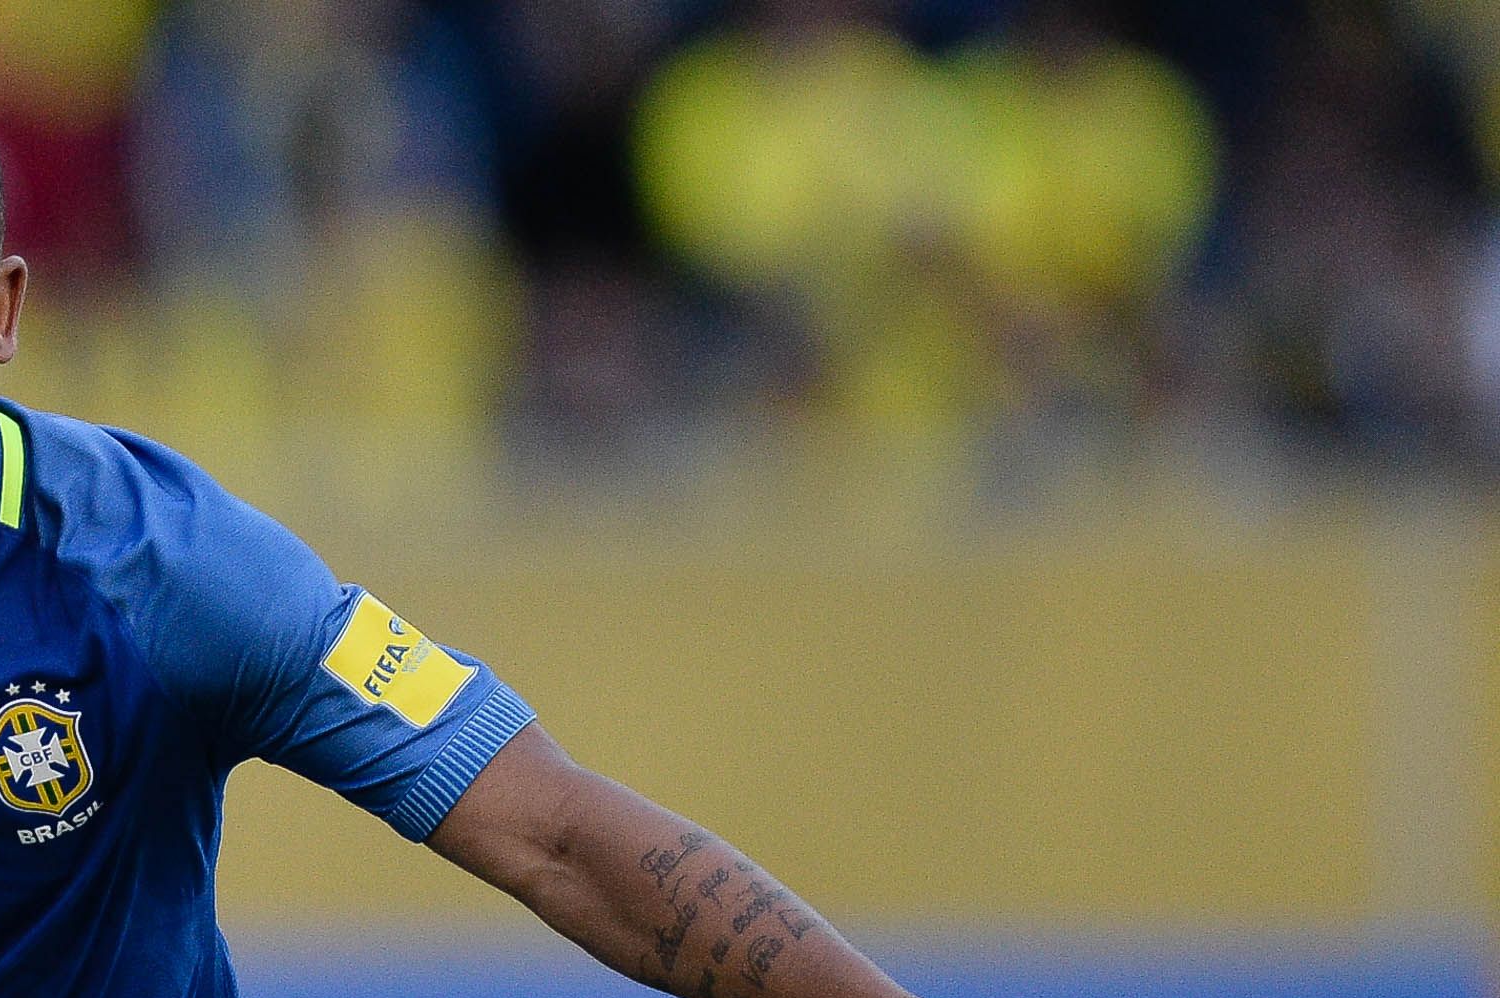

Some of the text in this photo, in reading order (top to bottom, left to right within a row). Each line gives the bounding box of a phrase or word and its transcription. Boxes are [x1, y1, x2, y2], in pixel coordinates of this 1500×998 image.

[364, 643, 410, 698] FIFA
[19, 749, 53, 767] CBF
[16, 800, 103, 845] BRASIL
